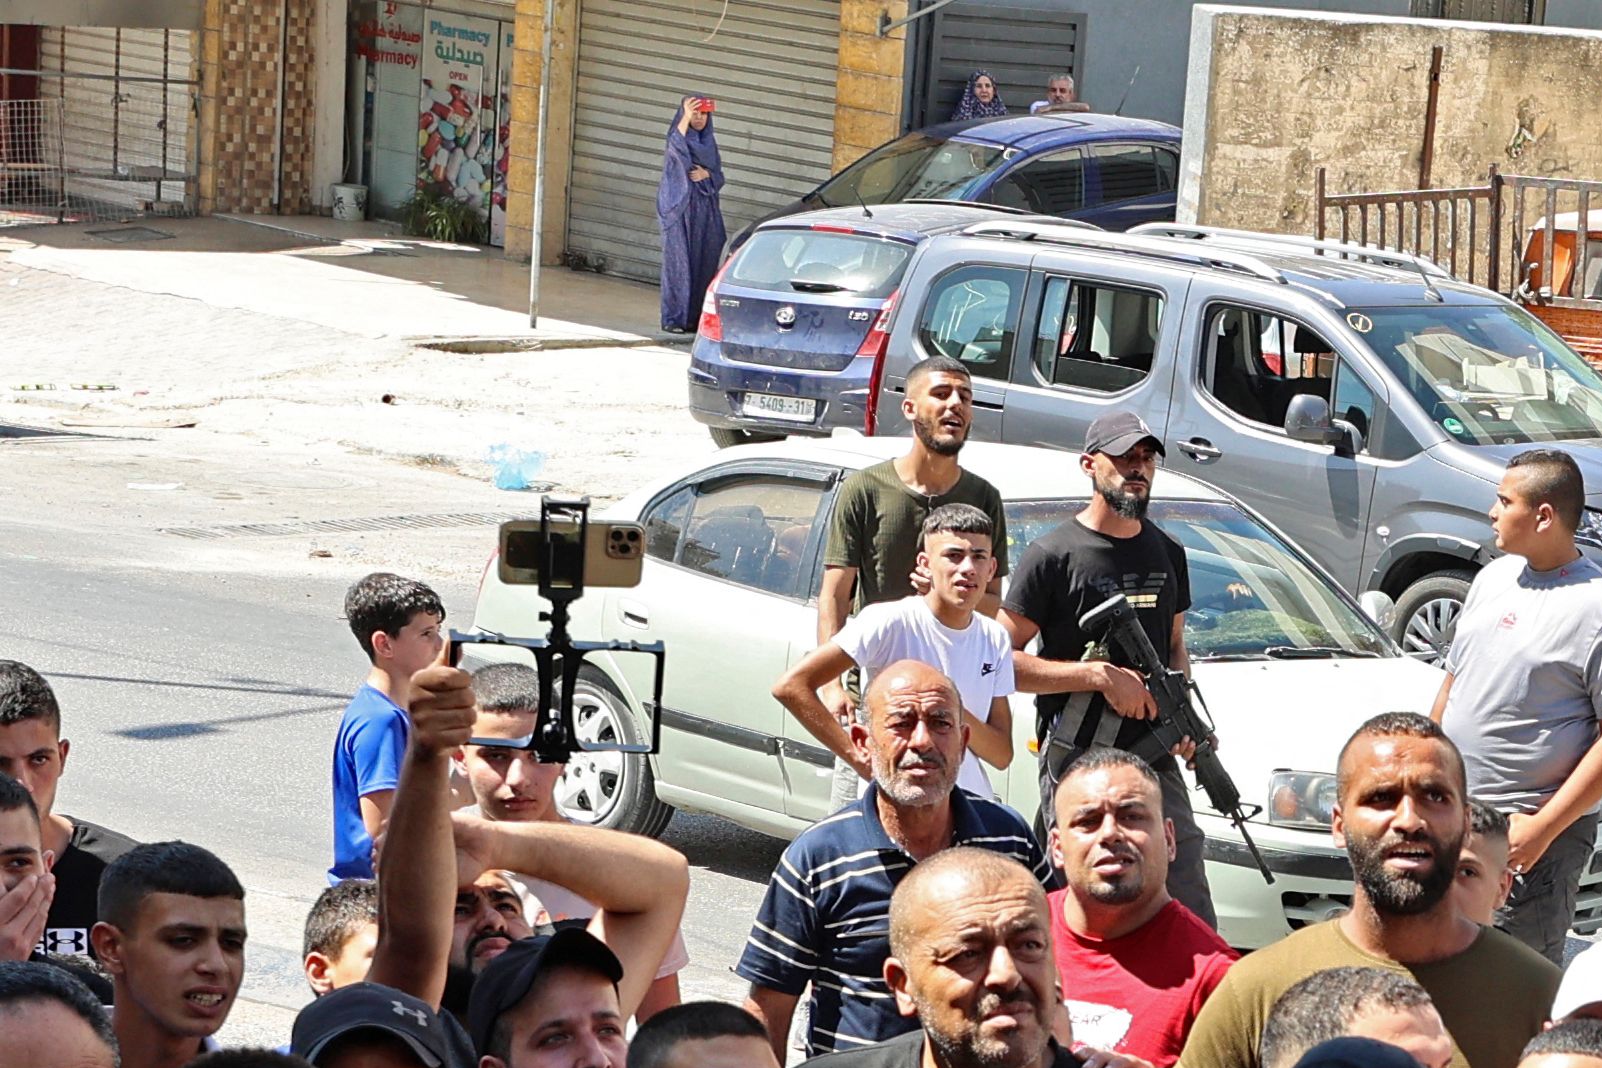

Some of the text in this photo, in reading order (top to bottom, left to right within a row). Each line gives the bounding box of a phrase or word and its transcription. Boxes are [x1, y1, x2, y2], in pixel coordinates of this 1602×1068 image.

[430, 20, 491, 47] Pharmacy
[435, 40, 484, 68] صيدلية
[449, 71, 469, 81] OPEN
